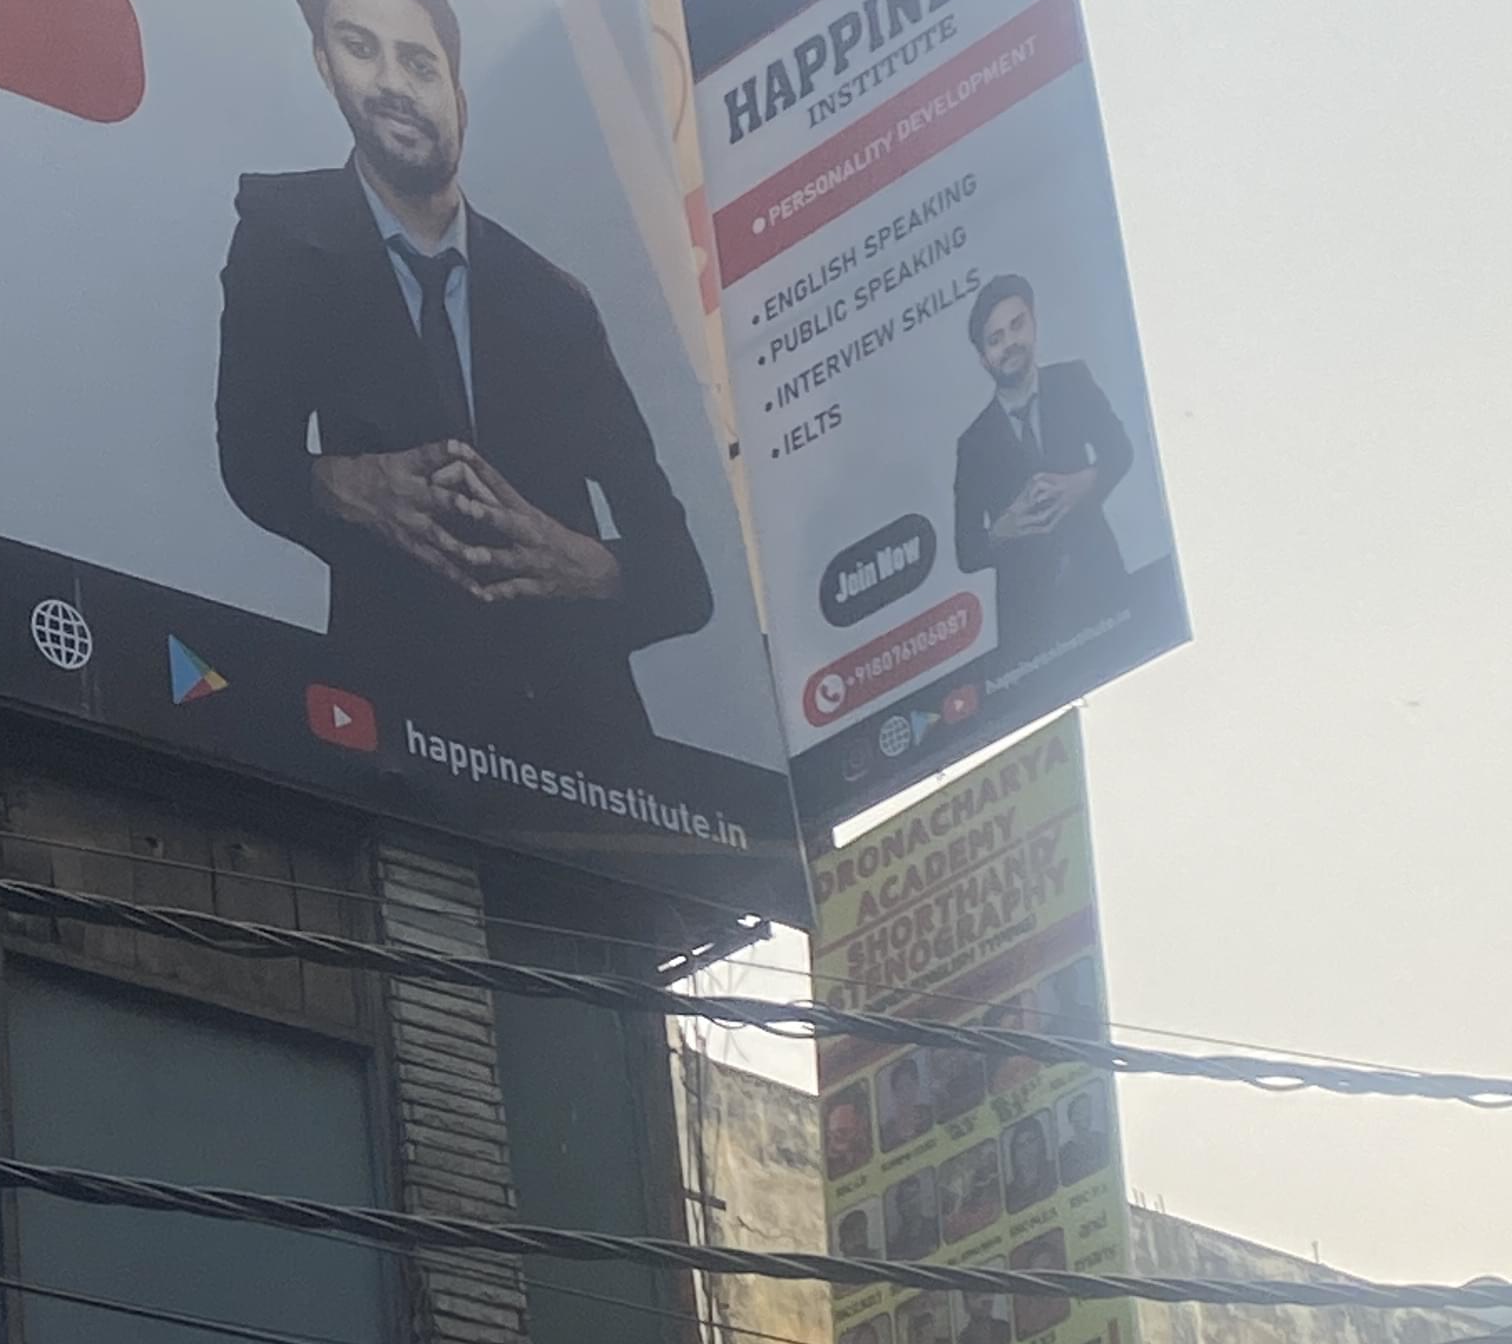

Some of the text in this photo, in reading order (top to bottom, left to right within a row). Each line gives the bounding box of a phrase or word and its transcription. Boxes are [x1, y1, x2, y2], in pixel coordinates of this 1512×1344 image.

[767, 34, 1039, 229] PERSONALITY DEVELOPMENT
[807, 13, 958, 130] INSTITUTE
[764, 171, 979, 324] ENGLISH SPEAKING
[769, 225, 968, 364] PUBLIC SPEAKING
[776, 267, 983, 409] INTERVIEW SKILLS
[783, 403, 844, 459] IELTS
[835, 560, 877, 604] Join
[406, 719, 748, 852] happinessinstitute.in
[814, 736, 1069, 905] DRONACHARYA
[856, 806, 1017, 928] ACADEMY
